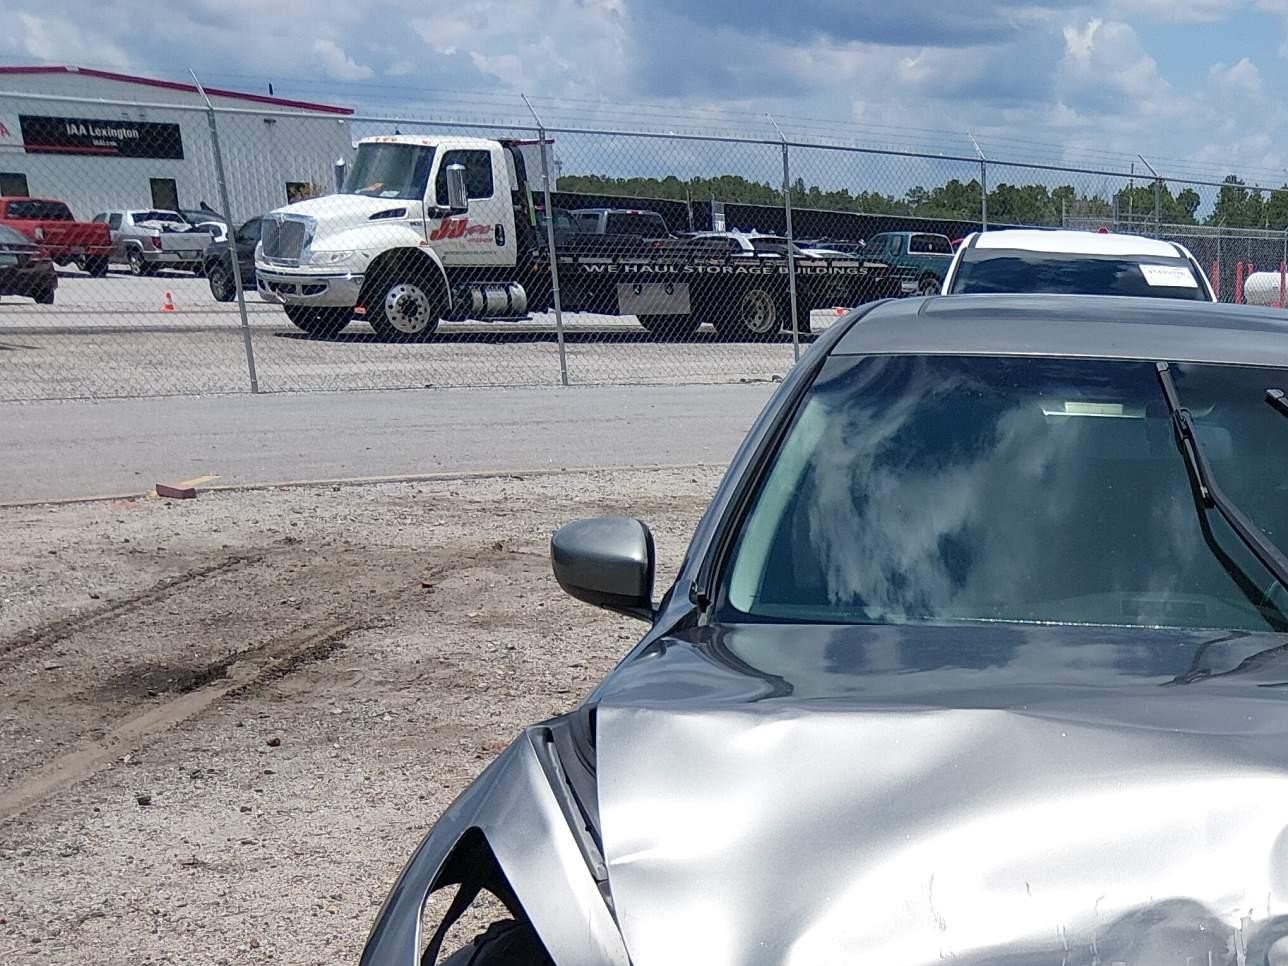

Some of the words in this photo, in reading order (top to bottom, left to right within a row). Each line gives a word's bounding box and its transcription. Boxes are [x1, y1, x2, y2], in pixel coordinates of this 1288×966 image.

[66, 123, 88, 136] IAA
[89, 125, 139, 140] Lexington
[583, 264, 618, 273] WE
[624, 265, 678, 273] HAUL
[682, 265, 773, 275] STORAGE
